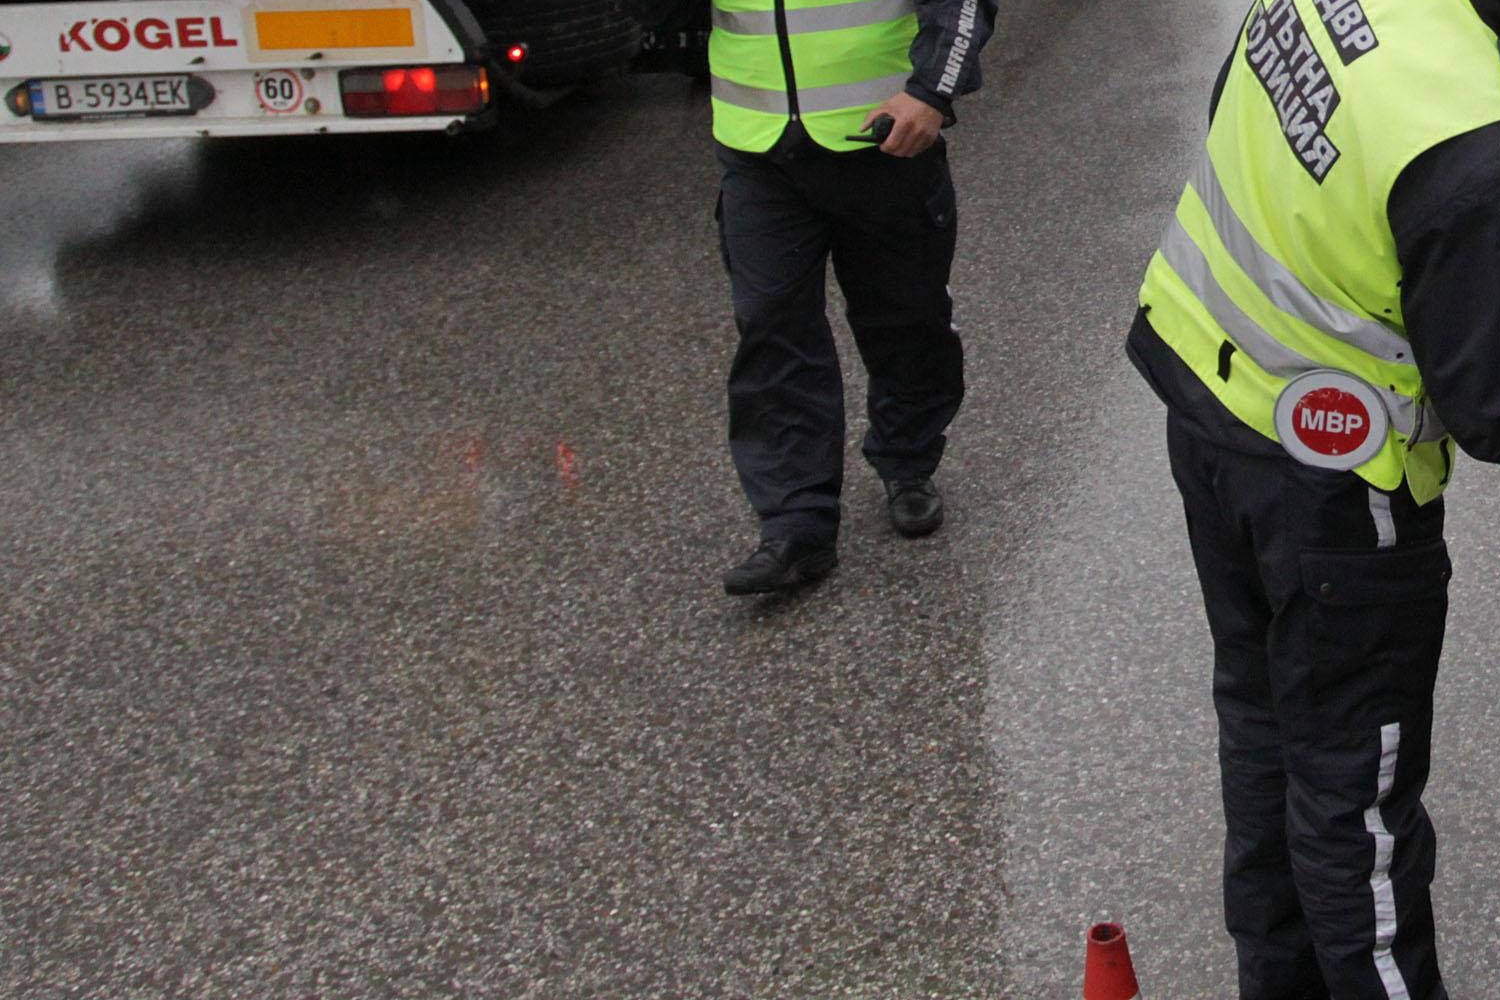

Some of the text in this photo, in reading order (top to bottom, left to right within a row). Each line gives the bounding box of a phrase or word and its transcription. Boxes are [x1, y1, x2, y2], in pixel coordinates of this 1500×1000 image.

[59, 16, 238, 53] KÖGEL
[936, 36, 970, 95] TRAFFIC
[85, 81, 147, 108] 5934
[264, 77, 295, 101] 60
[1247, 1, 1337, 178] ПОЛИЦИЯ
